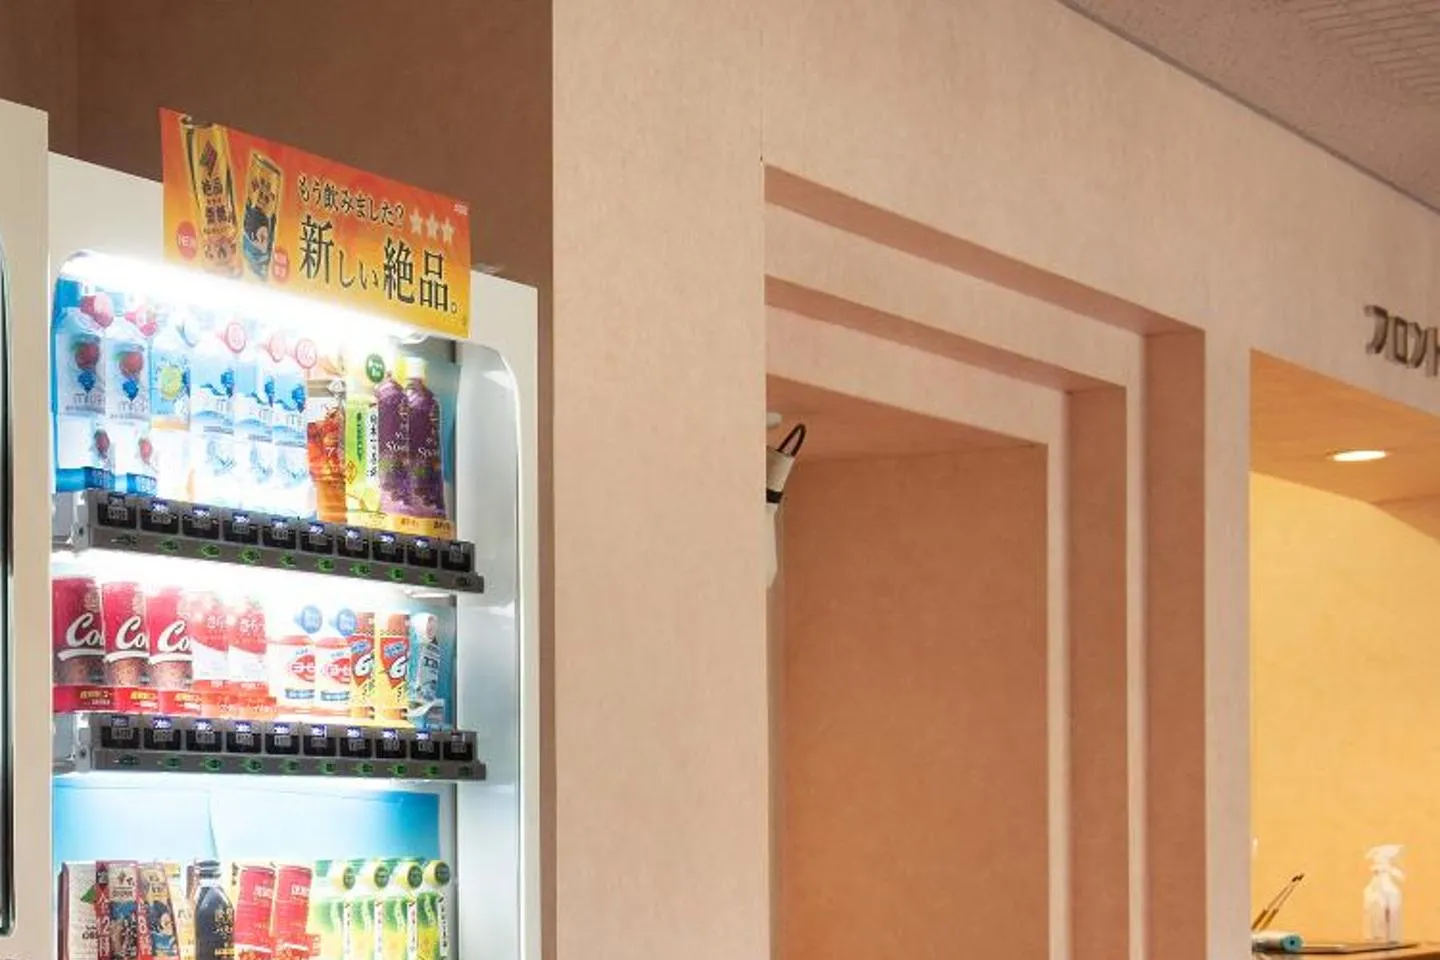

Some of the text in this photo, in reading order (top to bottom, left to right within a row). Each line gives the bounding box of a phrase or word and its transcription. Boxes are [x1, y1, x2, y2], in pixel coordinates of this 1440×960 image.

[299, 215, 458, 314] 新しい絶品。
